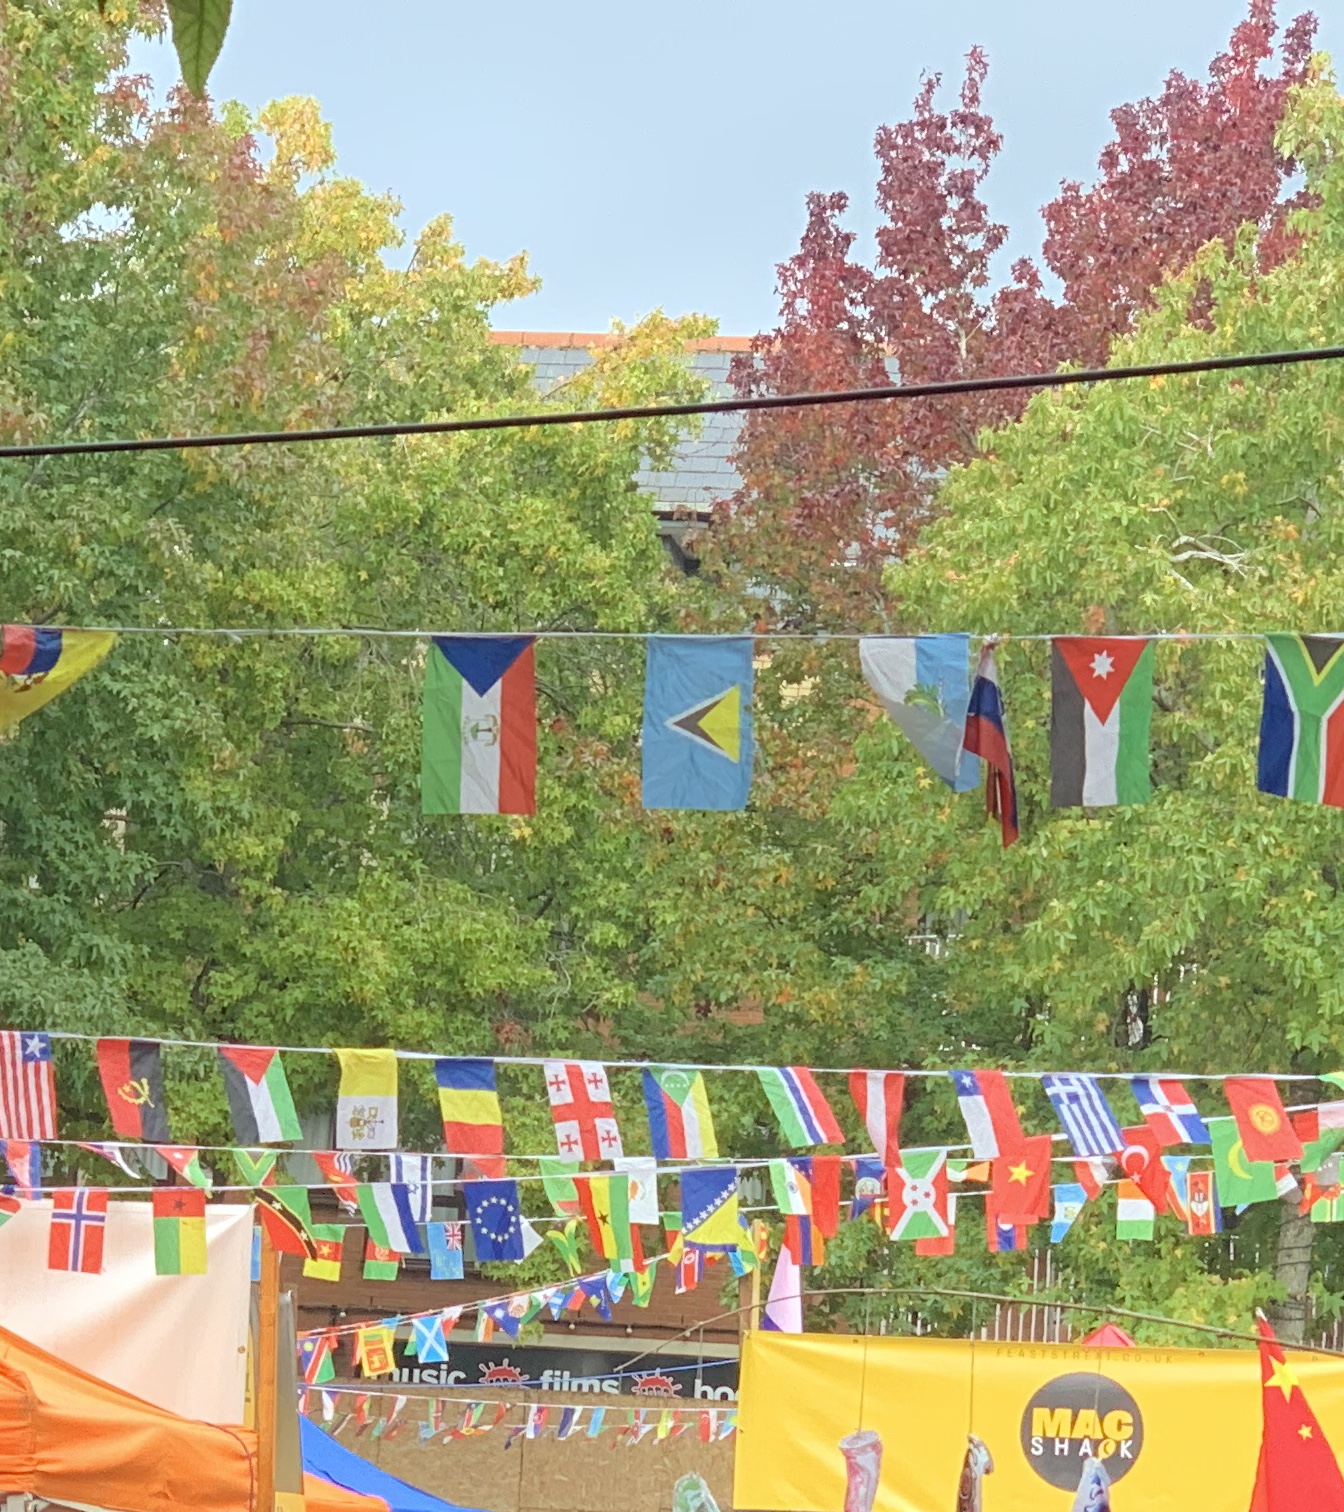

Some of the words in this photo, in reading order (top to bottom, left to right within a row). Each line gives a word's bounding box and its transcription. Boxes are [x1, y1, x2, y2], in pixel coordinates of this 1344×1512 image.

[540, 1369, 620, 1395] films
[1032, 1406, 1133, 1440] MAC
[1030, 1436, 1133, 1461] SHACK
